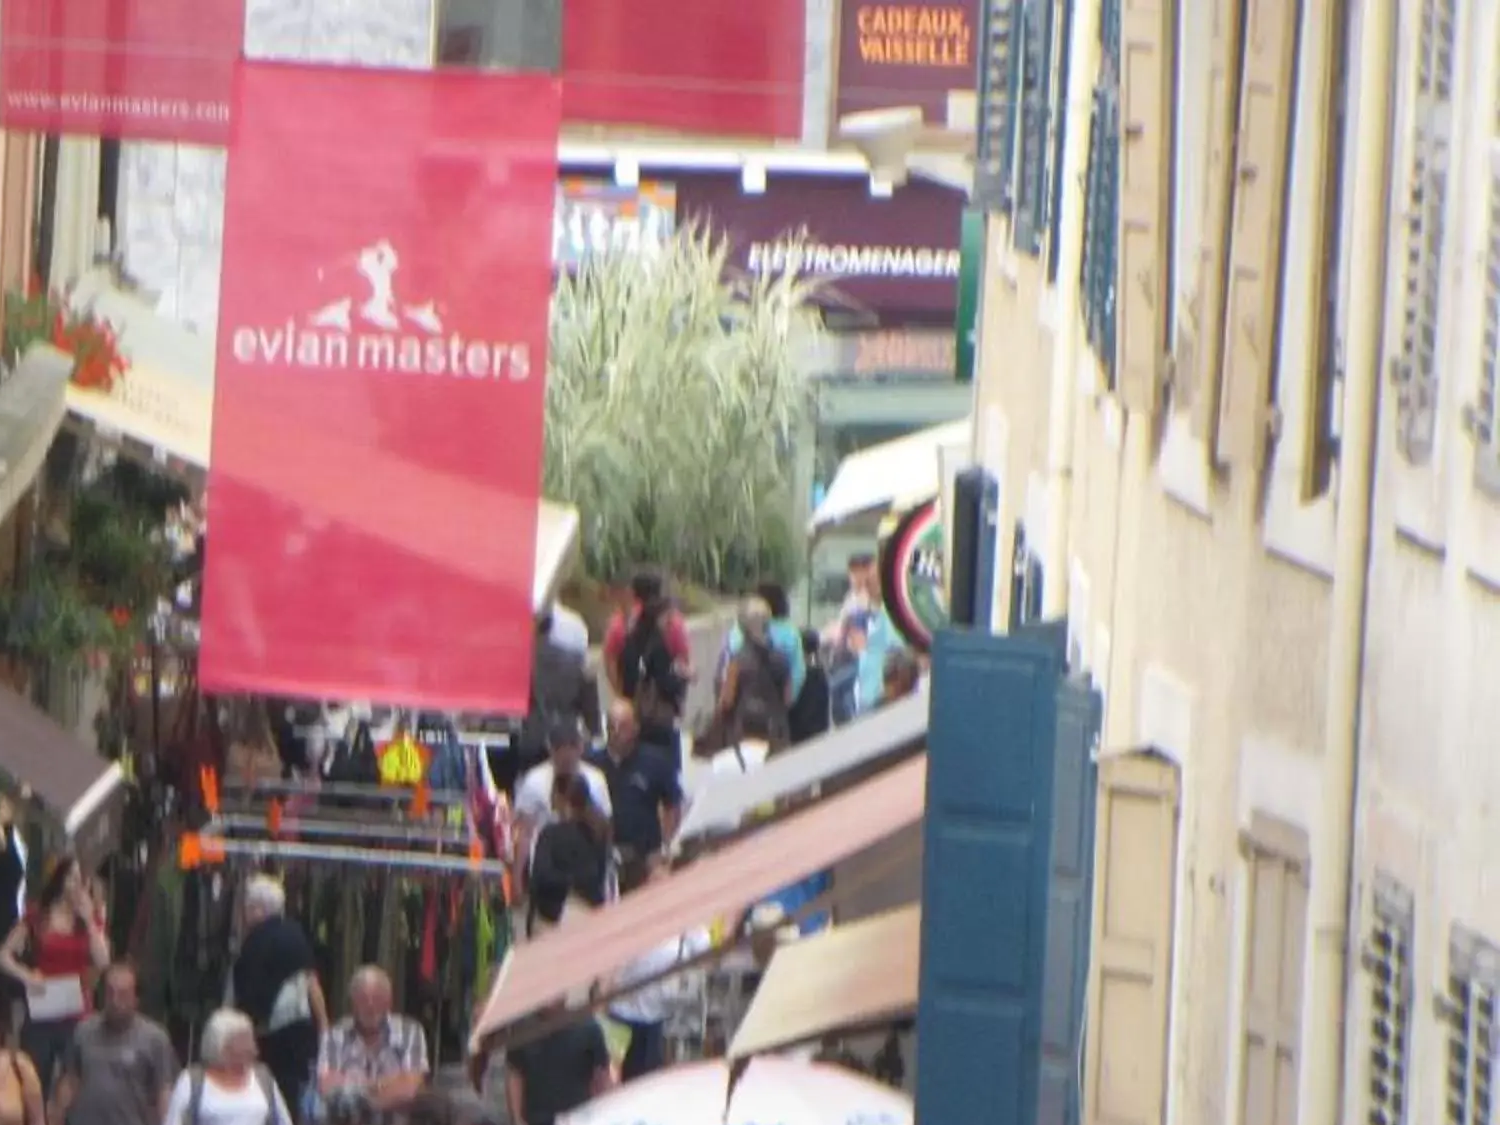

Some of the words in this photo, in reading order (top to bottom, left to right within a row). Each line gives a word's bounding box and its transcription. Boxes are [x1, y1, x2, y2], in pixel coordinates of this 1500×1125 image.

[859, 38, 969, 65] VAISSELLE
[748, 241, 962, 277] ELETROMENAGER
[233, 318, 348, 368] evian
[358, 332, 530, 382] masters
